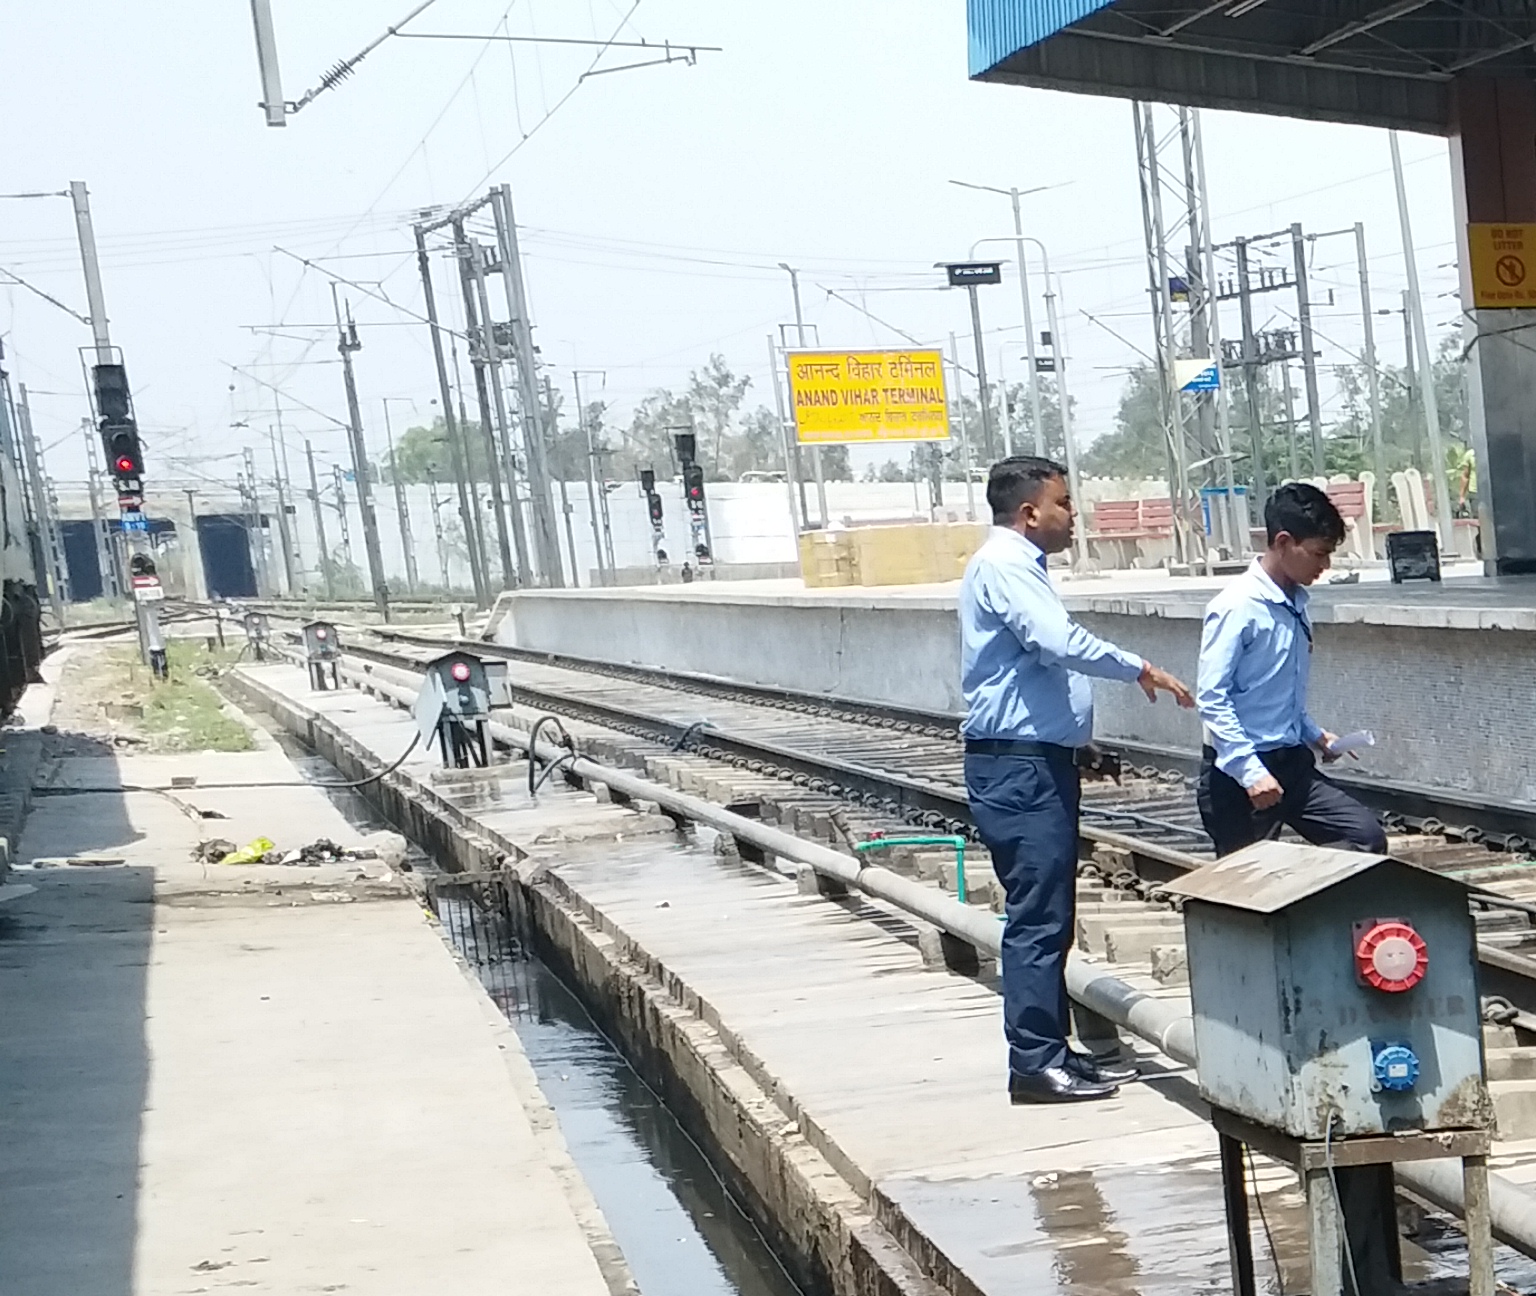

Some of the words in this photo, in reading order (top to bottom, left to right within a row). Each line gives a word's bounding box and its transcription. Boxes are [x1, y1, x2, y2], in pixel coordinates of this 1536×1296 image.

[797, 362, 840, 380] आनन्द
[847, 356, 883, 381] विहार
[797, 389, 838, 407] ANAND
[840, 388, 880, 406] VIHAR
[882, 387, 944, 405] TERMINAL
